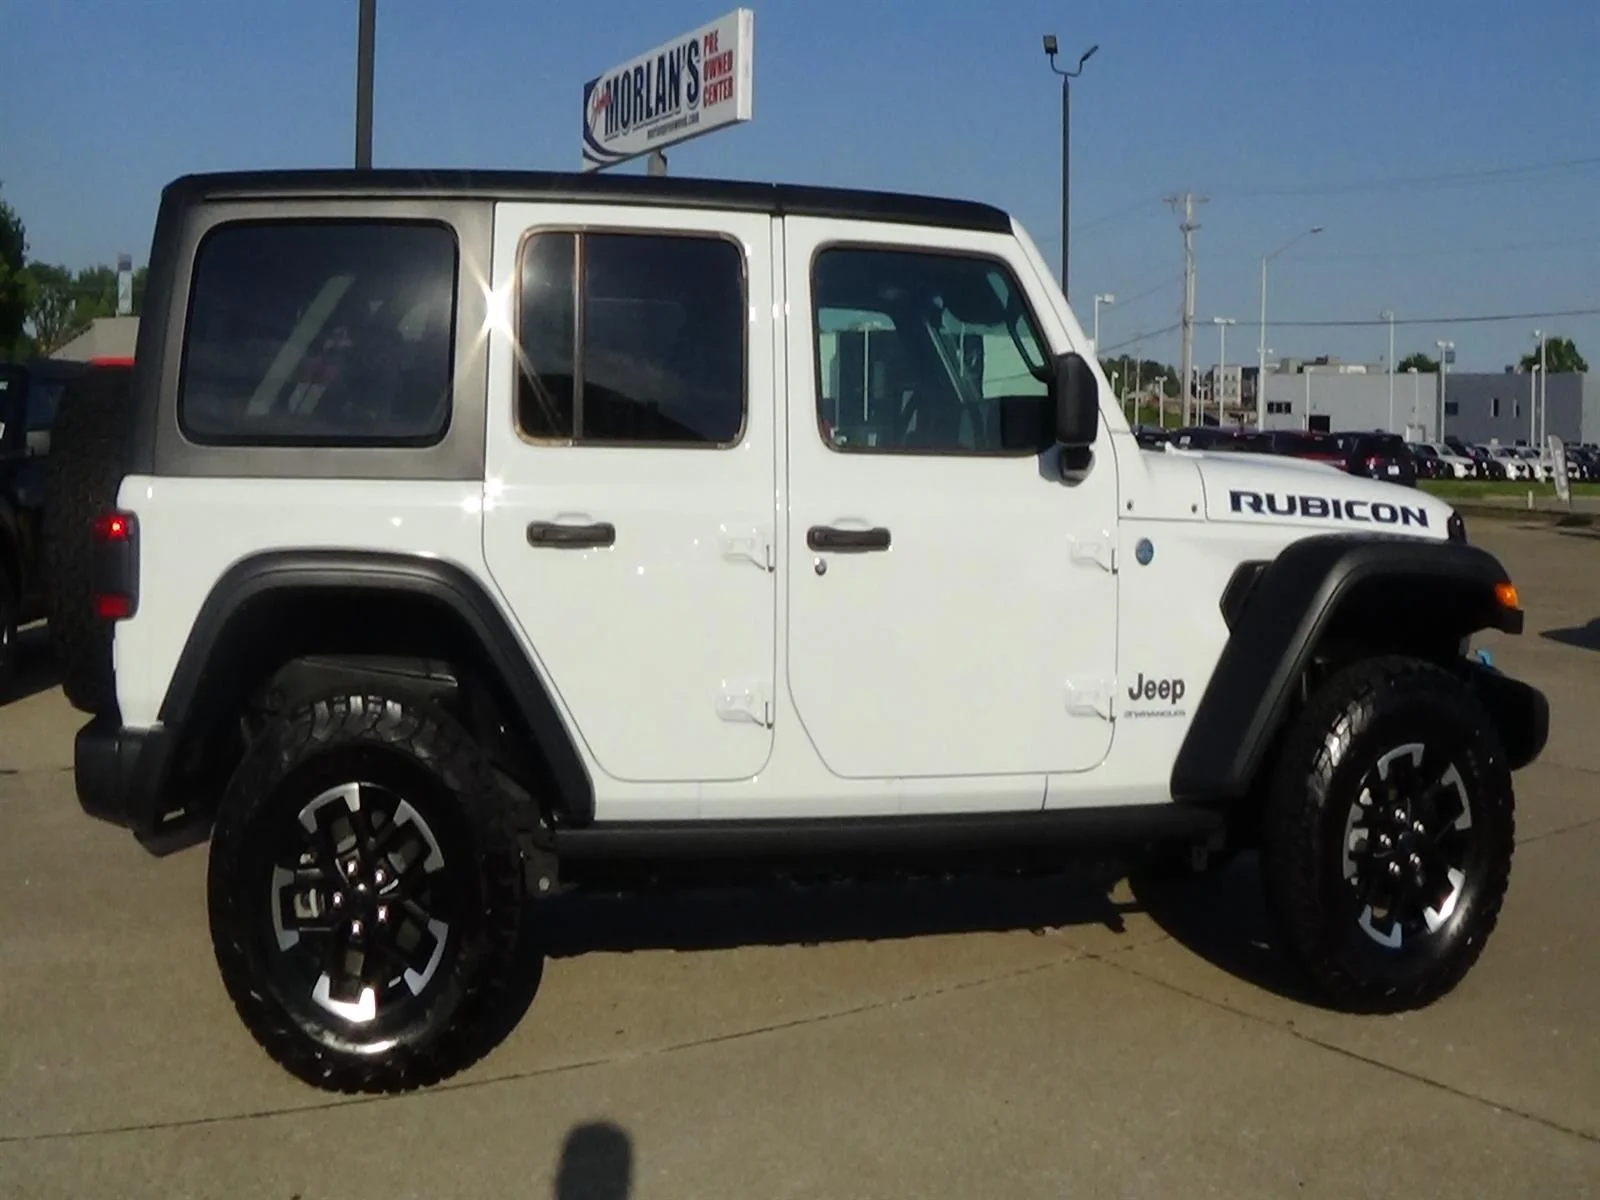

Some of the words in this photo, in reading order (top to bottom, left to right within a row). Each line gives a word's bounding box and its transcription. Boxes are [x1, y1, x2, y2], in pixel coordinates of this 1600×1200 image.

[703, 30, 719, 58] PRE
[703, 50, 733, 82] OWNED
[604, 38, 700, 136] MORLAN'S
[703, 76, 733, 108] CENTER
[1229, 490, 1428, 528] RUBICON
[1128, 673, 1185, 704] Jeep
